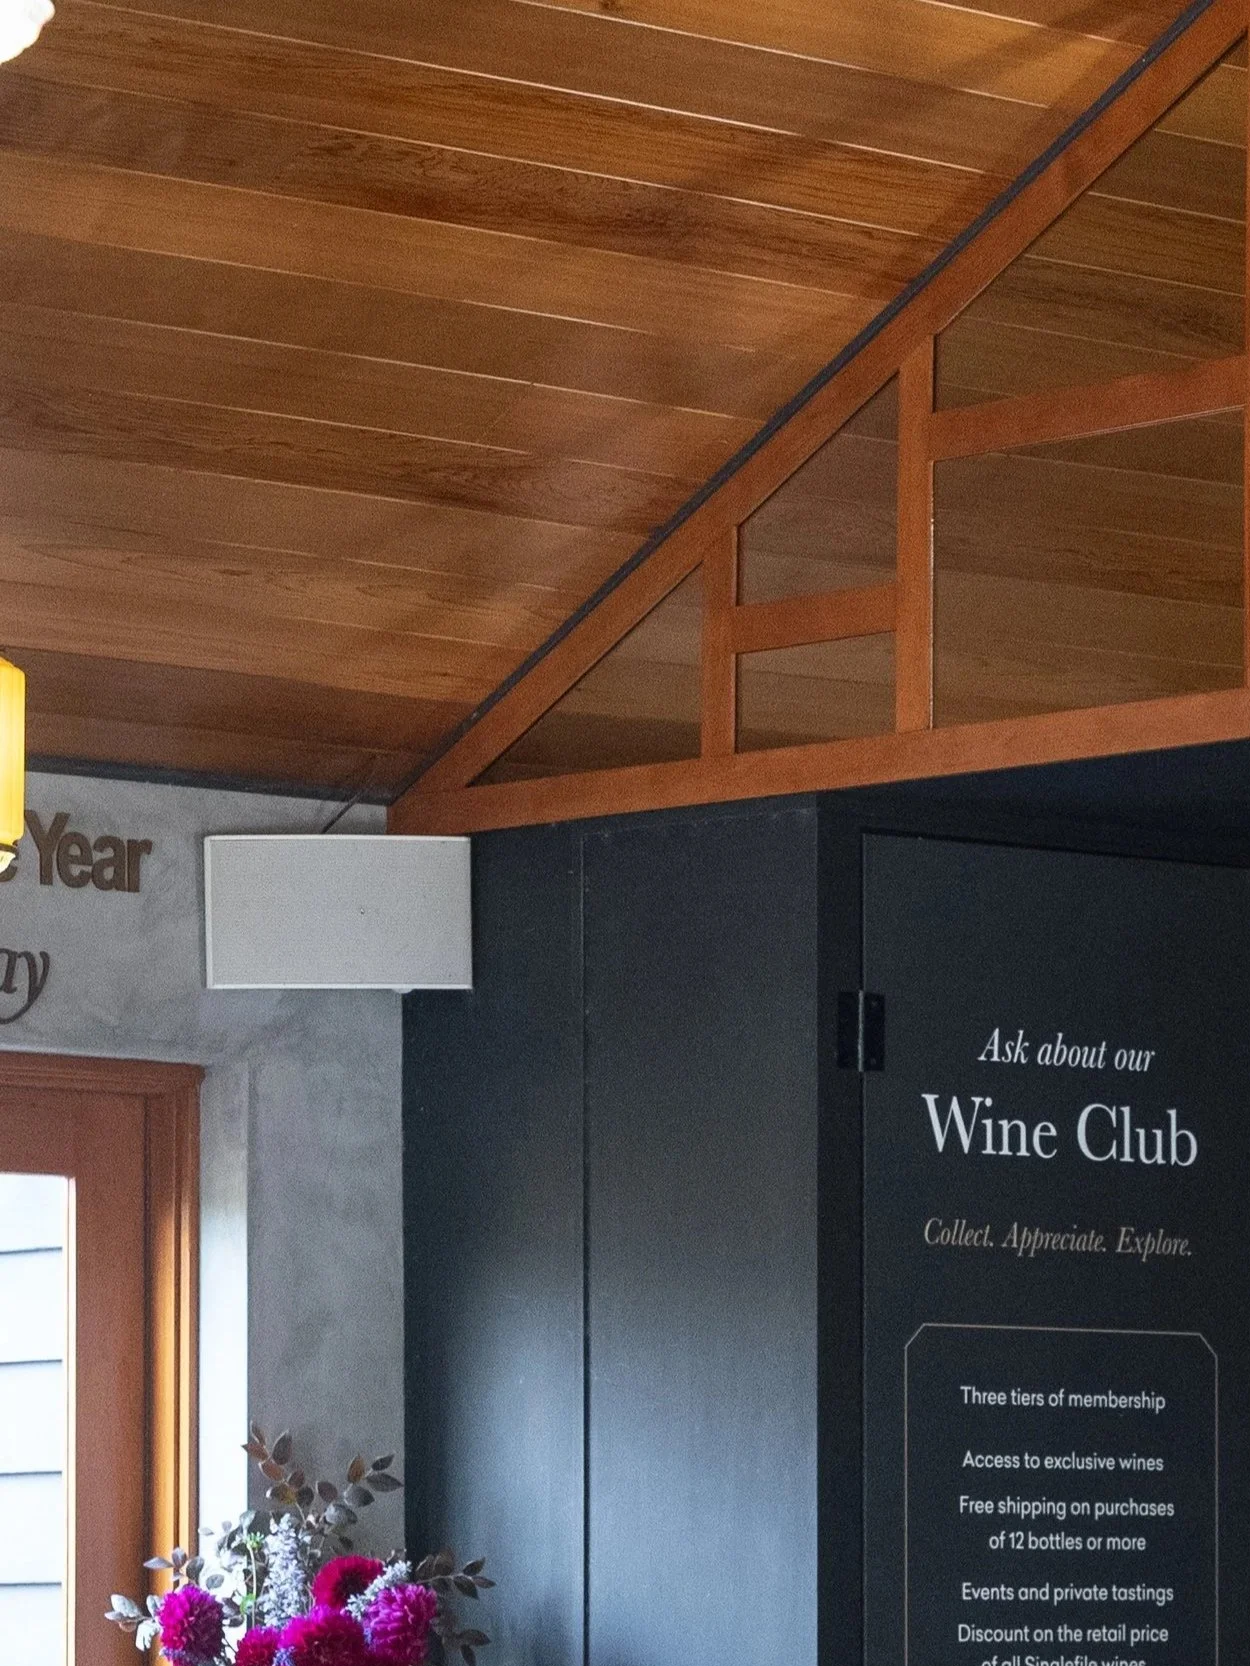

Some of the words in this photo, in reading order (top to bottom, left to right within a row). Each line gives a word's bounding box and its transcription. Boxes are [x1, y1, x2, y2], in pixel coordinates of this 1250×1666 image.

[24, 810, 153, 893] Year
[978, 1028, 1029, 1063] Ask
[1037, 1033, 1106, 1068] about
[1115, 1049, 1155, 1071] our
[922, 1094, 1057, 1158] Wine
[1077, 1104, 1197, 1166] Club
[924, 1218, 993, 1247] Collect.
[1001, 1222, 1106, 1257] Appreciate.
[1116, 1227, 1191, 1262] Explore.
[960, 1386, 1007, 1405] Three
[1011, 1388, 1044, 1406] tiers
[1048, 1389, 1064, 1406] of
[1068, 1390, 1165, 1413] membership
[962, 1451, 1020, 1468] Access
[1024, 1453, 1040, 1469] to
[1044, 1452, 1115, 1470] exclusive
[1119, 1453, 1163, 1471] wines
[960, 1495, 994, 1514] Free
[998, 1496, 1066, 1520] shipping
[1071, 1502, 1090, 1515] on
[1095, 1498, 1174, 1520] purchases
[989, 1531, 1005, 1549] of
[1009, 1531, 1024, 1549] 12
[1028, 1532, 1082, 1550] bottles
[1087, 1537, 1102, 1550] or
[1107, 1537, 1146, 1550] more
[962, 1582, 1014, 1600] Events
[1018, 1583, 1049, 1600] and
[1054, 1583, 1108, 1605] private
[1112, 1584, 1173, 1606] tastings
[958, 1624, 1029, 1642] Discount
[1033, 1629, 1053, 1642] on
[1057, 1624, 1083, 1642] the
[1087, 1624, 1126, 1642] retail
[1130, 1625, 1168, 1646] price
